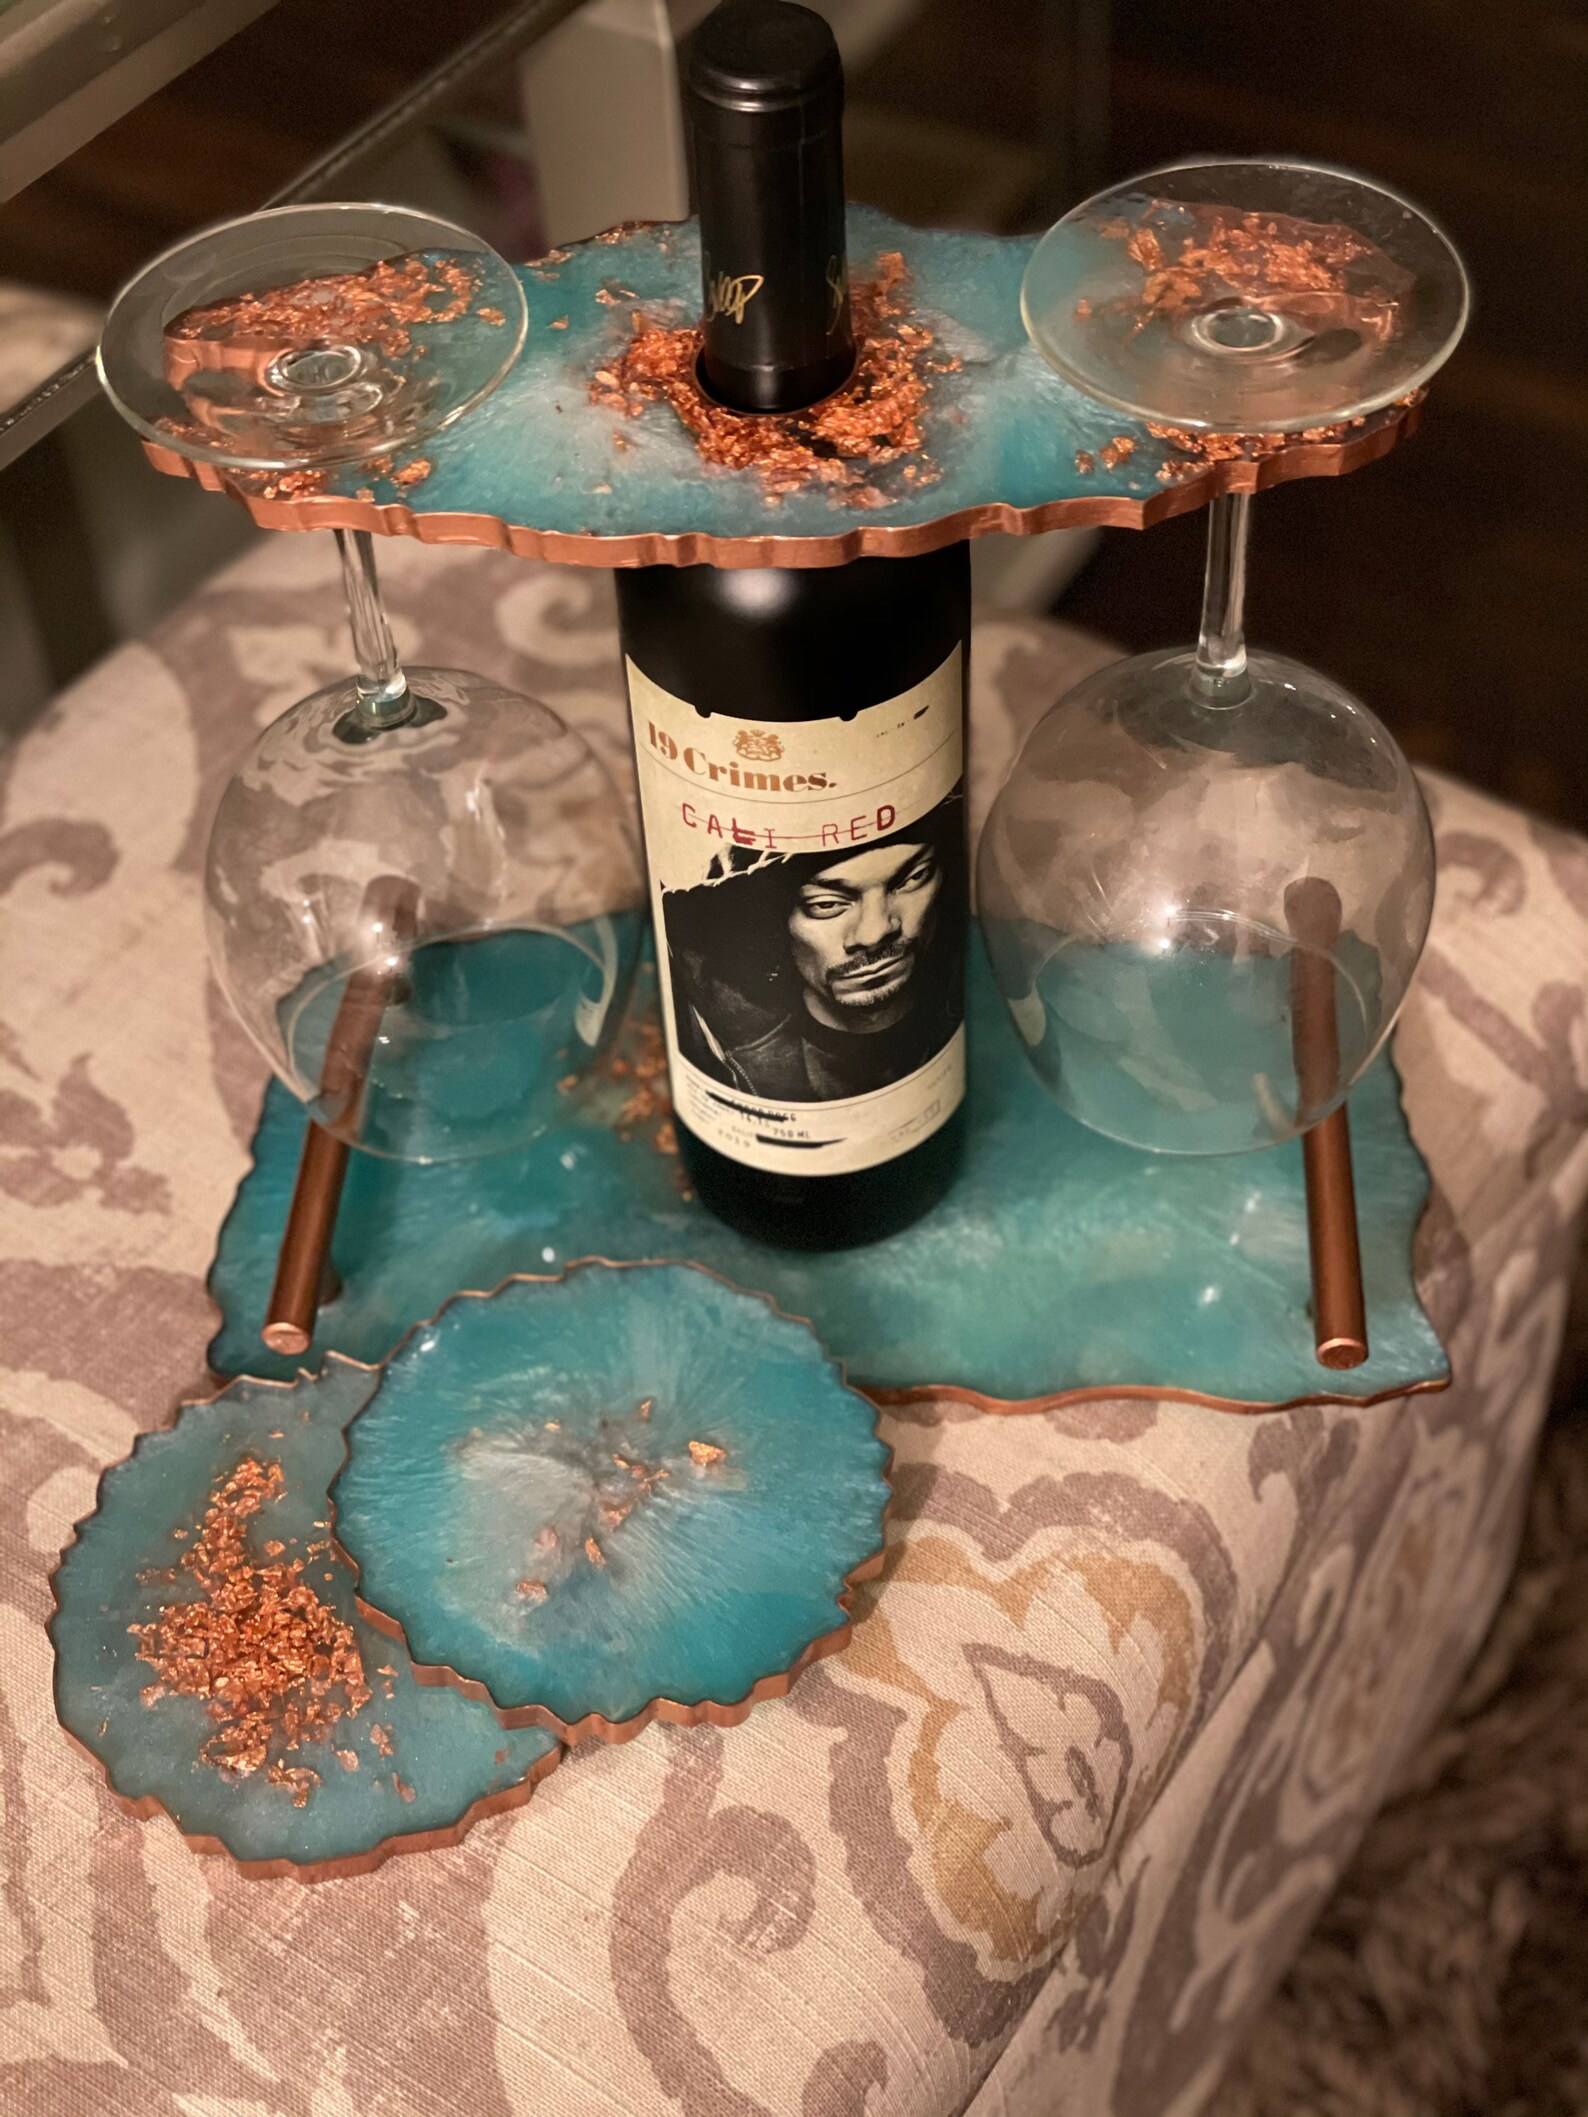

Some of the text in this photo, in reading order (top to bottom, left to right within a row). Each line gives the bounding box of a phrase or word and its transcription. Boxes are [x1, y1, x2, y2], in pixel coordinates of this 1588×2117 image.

[648, 719, 679, 761] 19
[682, 802, 896, 849] CALI RED
